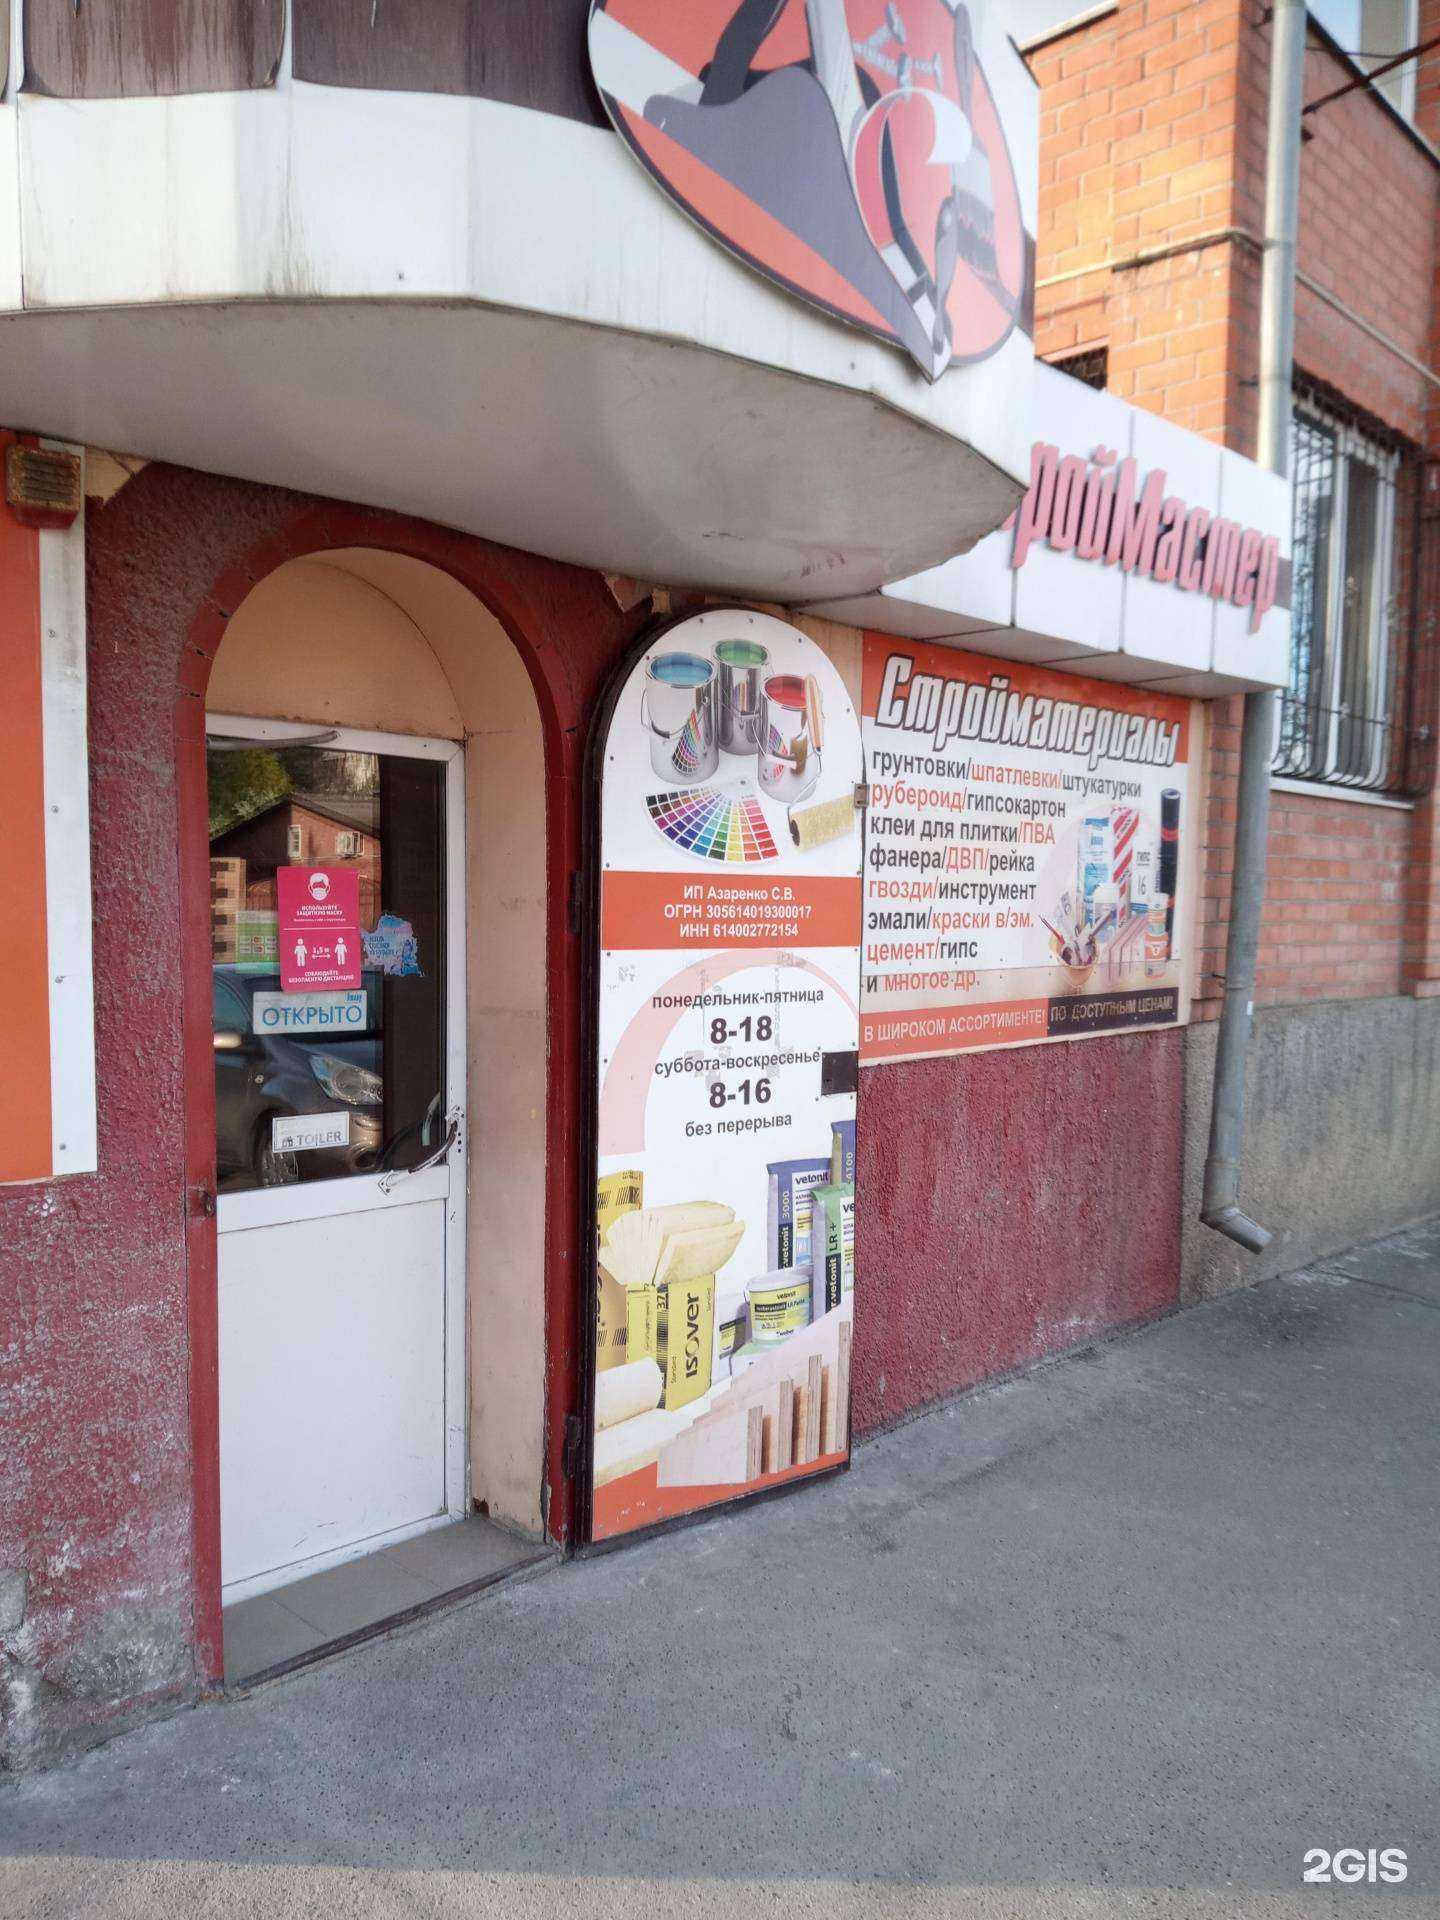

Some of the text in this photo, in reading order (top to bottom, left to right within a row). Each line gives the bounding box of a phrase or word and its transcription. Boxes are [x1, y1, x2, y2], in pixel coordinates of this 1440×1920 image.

[1002, 441, 1279, 634] ройМастер
[874, 653, 1181, 771] Стройматериалы
[871, 817, 917, 837] клеи
[920, 820, 954, 839] для
[683, 885, 796, 902] ИП Азаренко С.В.
[664, 904, 702, 919] ОГРН
[679, 924, 710, 938] ИНН
[866, 970, 980, 993] и многое др.
[652, 988, 825, 1009] понедельник-пятница
[262, 1005, 362, 1027] ОТКРЫТО
[864, 1026, 874, 1043] В
[877, 1020, 946, 1041] ШИРОКОМ
[949, 1009, 1046, 1033] АССОРТИМЕНТЕ!
[1050, 1006, 1067, 1022] ПО
[1071, 1000, 1136, 1022] ДОСТУПНЫМ
[710, 1015, 773, 1045] 8-18
[654, 1051, 821, 1079] суббота-воскресенье
[709, 1078, 772, 1109] 8-16
[685, 1114, 793, 1138] без перерыва
[795, 1172, 829, 1185] vetonit
